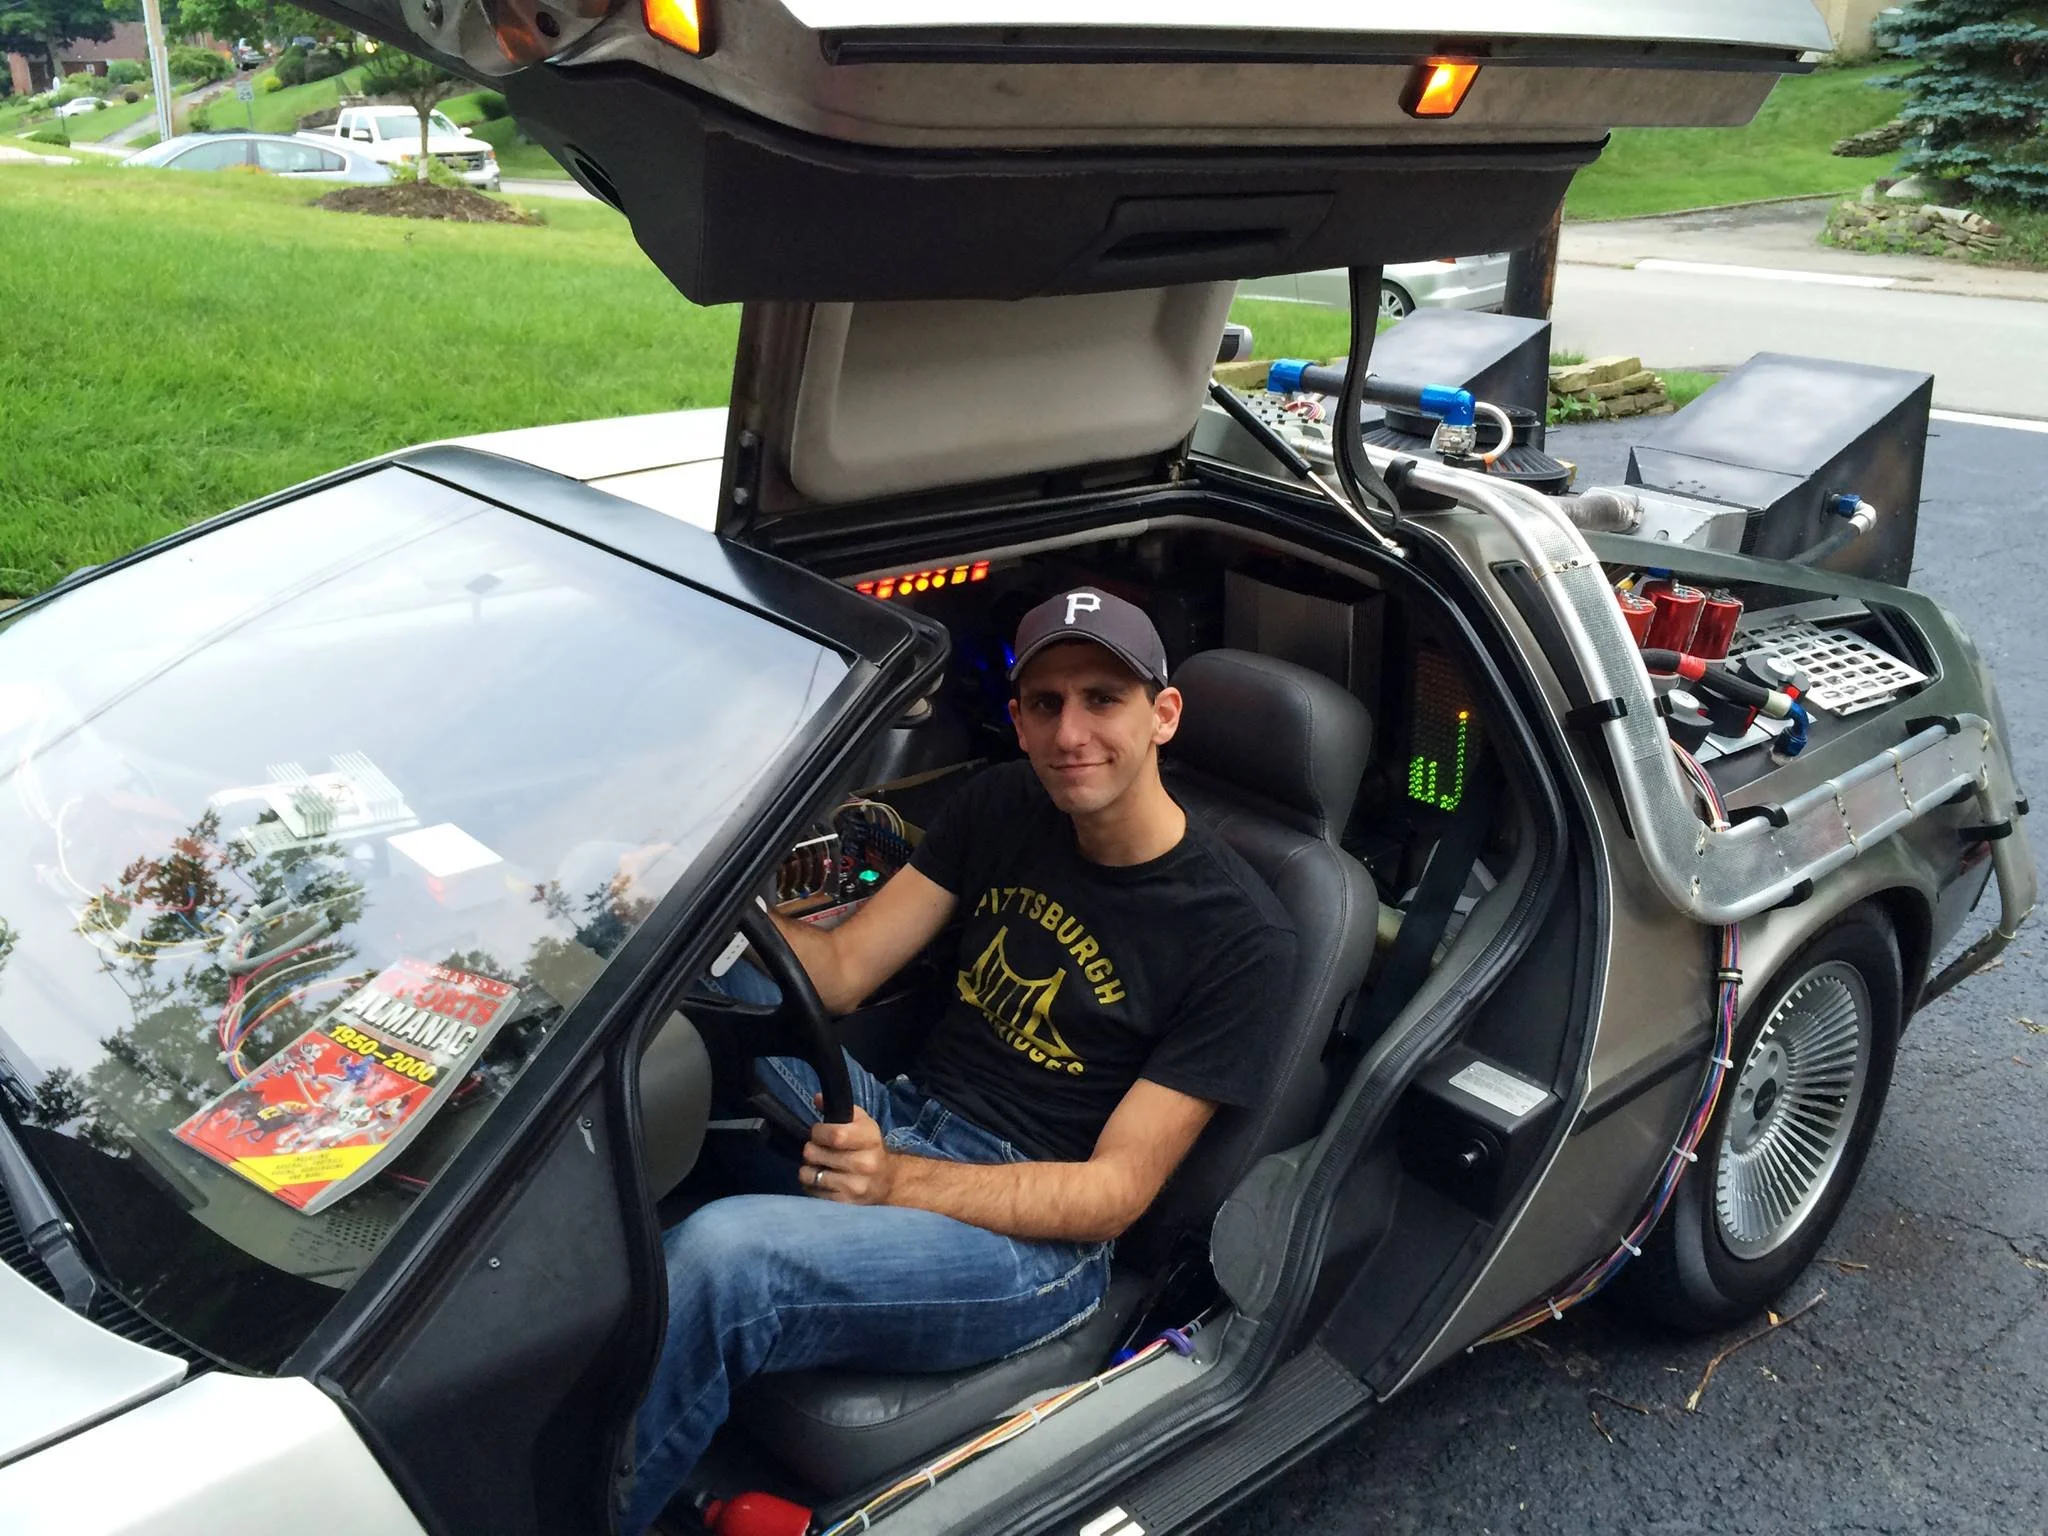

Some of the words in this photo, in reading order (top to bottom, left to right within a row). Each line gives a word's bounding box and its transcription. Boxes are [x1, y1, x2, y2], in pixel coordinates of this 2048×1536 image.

[1064, 593, 1101, 625] P
[343, 988, 478, 1057] ALMANAC
[328, 1024, 437, 1082] 1950-2000
